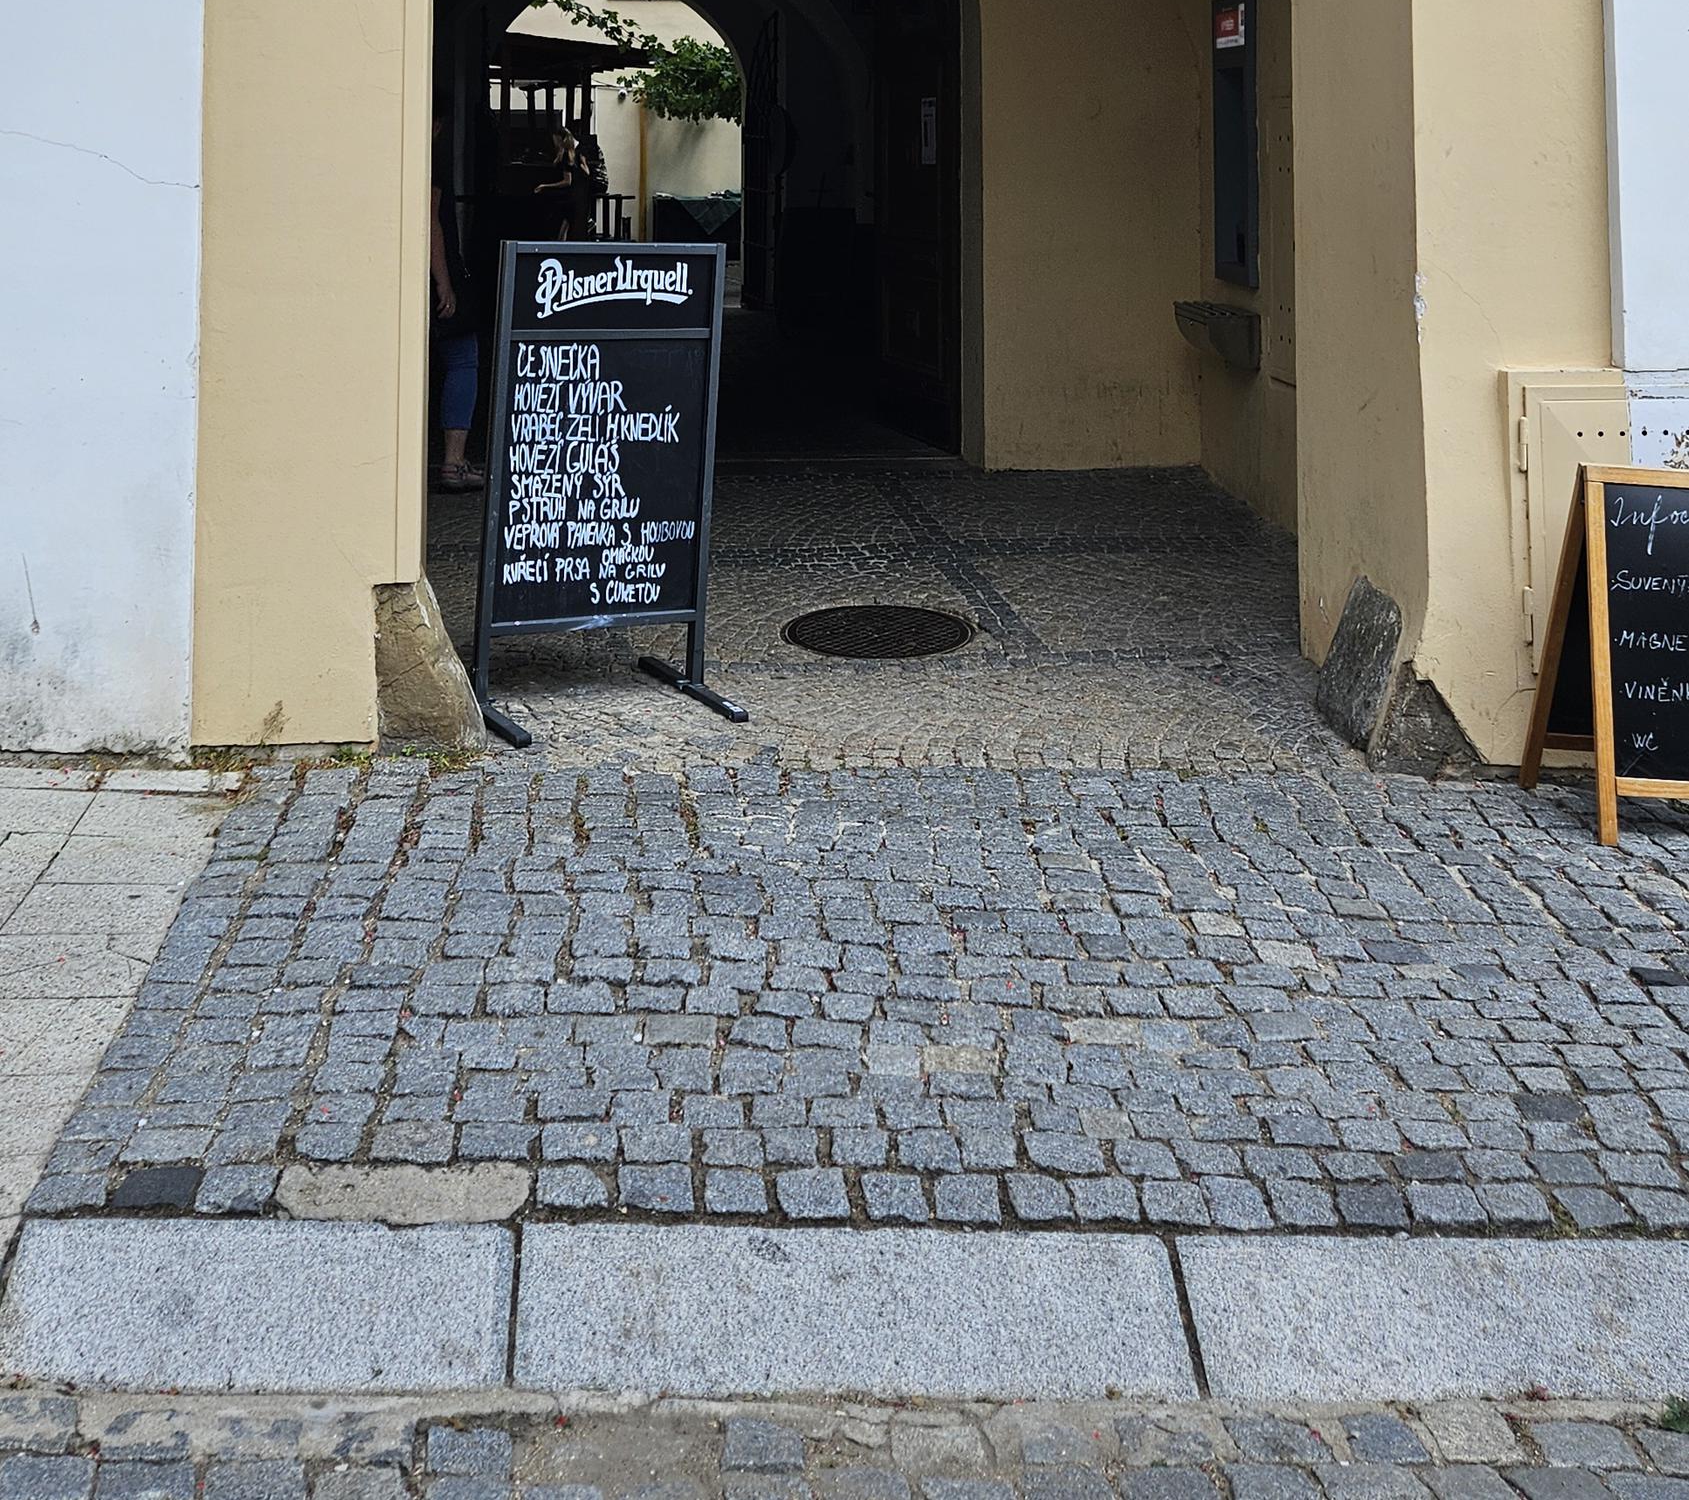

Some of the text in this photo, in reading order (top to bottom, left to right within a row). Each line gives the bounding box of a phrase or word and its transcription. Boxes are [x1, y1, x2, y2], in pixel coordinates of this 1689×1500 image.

[535, 258, 617, 318] Pilsner
[569, 379, 627, 414] VÝVAR
[566, 437, 620, 474] GULÁŠ
[593, 471, 626, 498] SÝR
[509, 497, 640, 524] PSTRUH NA GRILU
[566, 520, 615, 548] PANENKA
[621, 522, 632, 546] S
[503, 553, 666, 585] KUŘECÍ PRSA NA GRILU
[590, 580, 661, 604] S CUKETOU
[1632, 732, 1659, 751] WC
